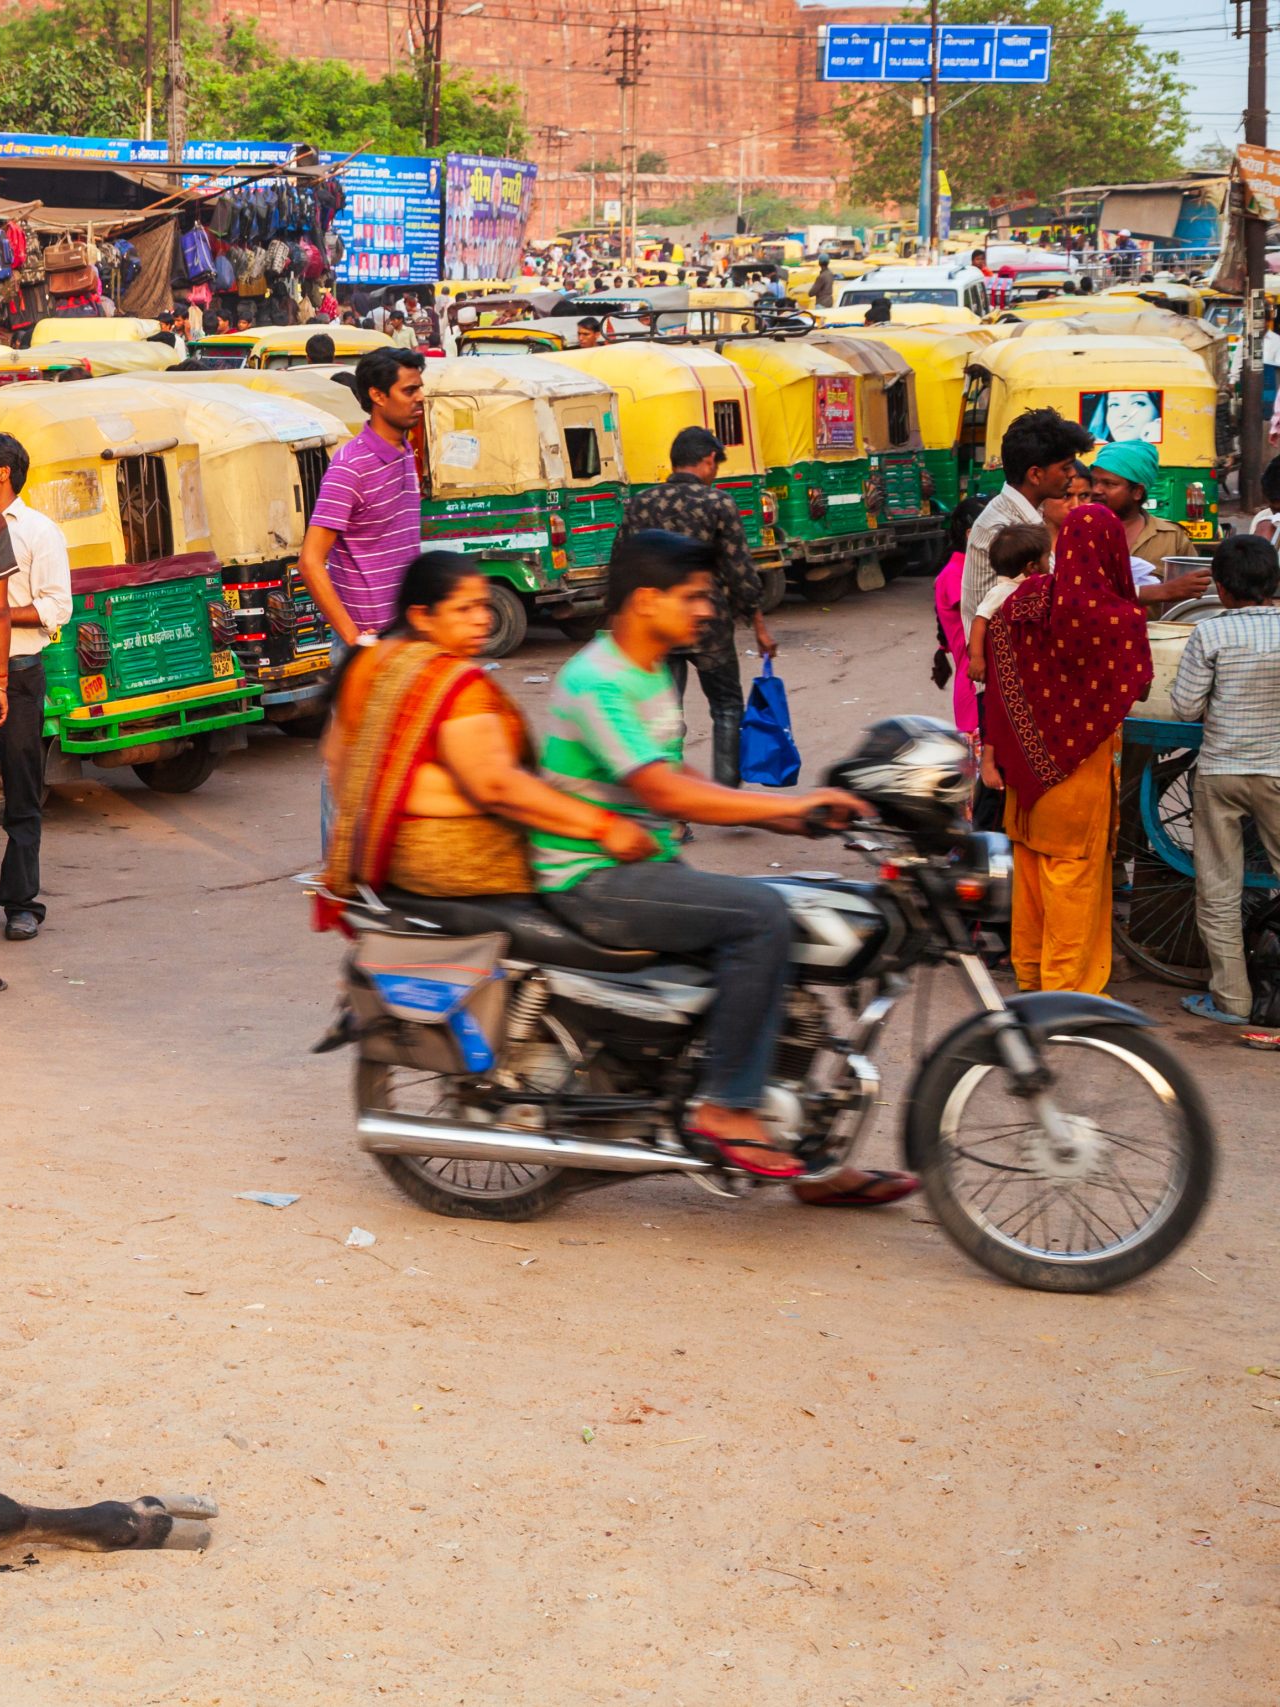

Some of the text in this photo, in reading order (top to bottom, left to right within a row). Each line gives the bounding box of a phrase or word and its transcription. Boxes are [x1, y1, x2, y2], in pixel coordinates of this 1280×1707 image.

[831, 57, 864, 65] RED FORT
[889, 58, 925, 66] TAJ MAHAL
[84, 677, 103, 699] STOP
